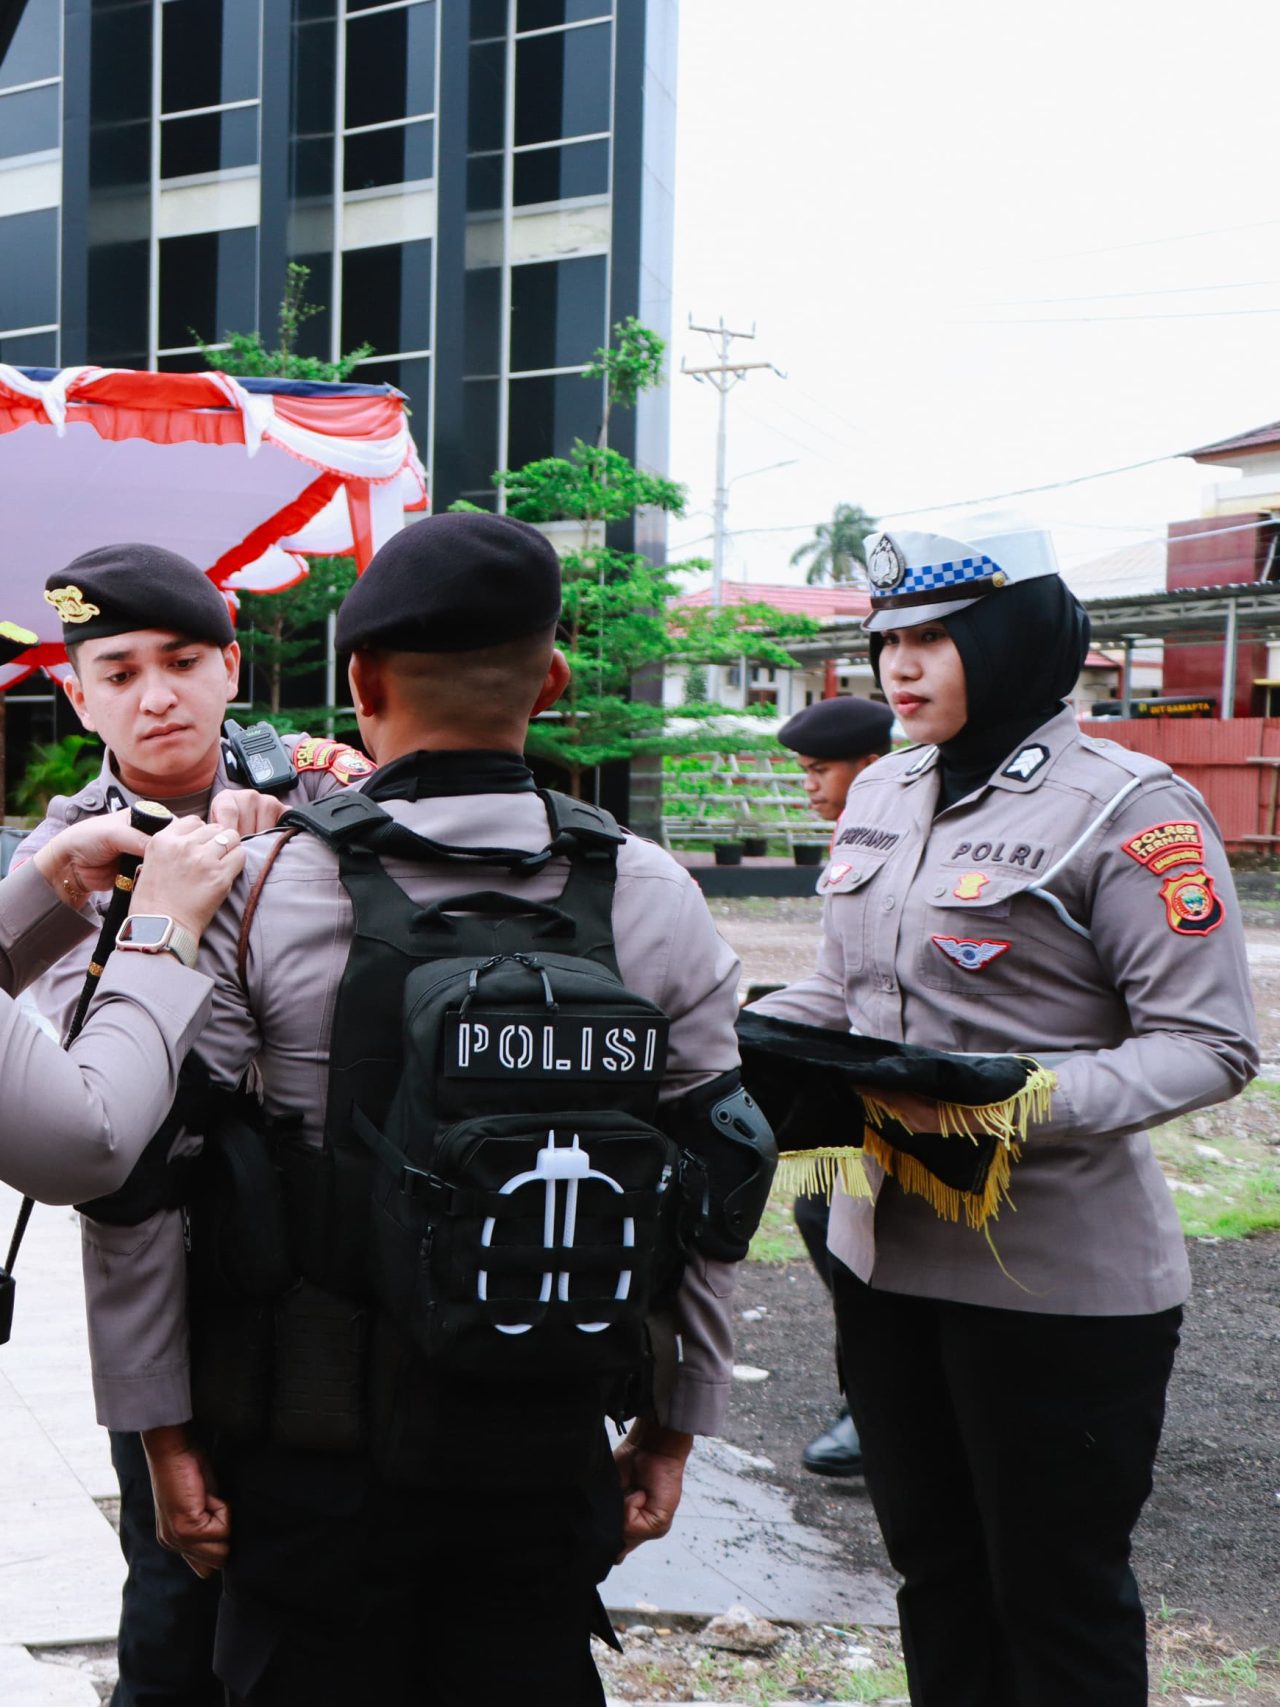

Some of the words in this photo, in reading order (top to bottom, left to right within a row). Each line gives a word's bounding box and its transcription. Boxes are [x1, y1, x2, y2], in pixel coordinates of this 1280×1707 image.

[1130, 824, 1196, 852] POLRES
[1138, 835, 1199, 857] TERNATE
[951, 841, 1045, 870] POLRI
[458, 1023, 657, 1072] POLISI
